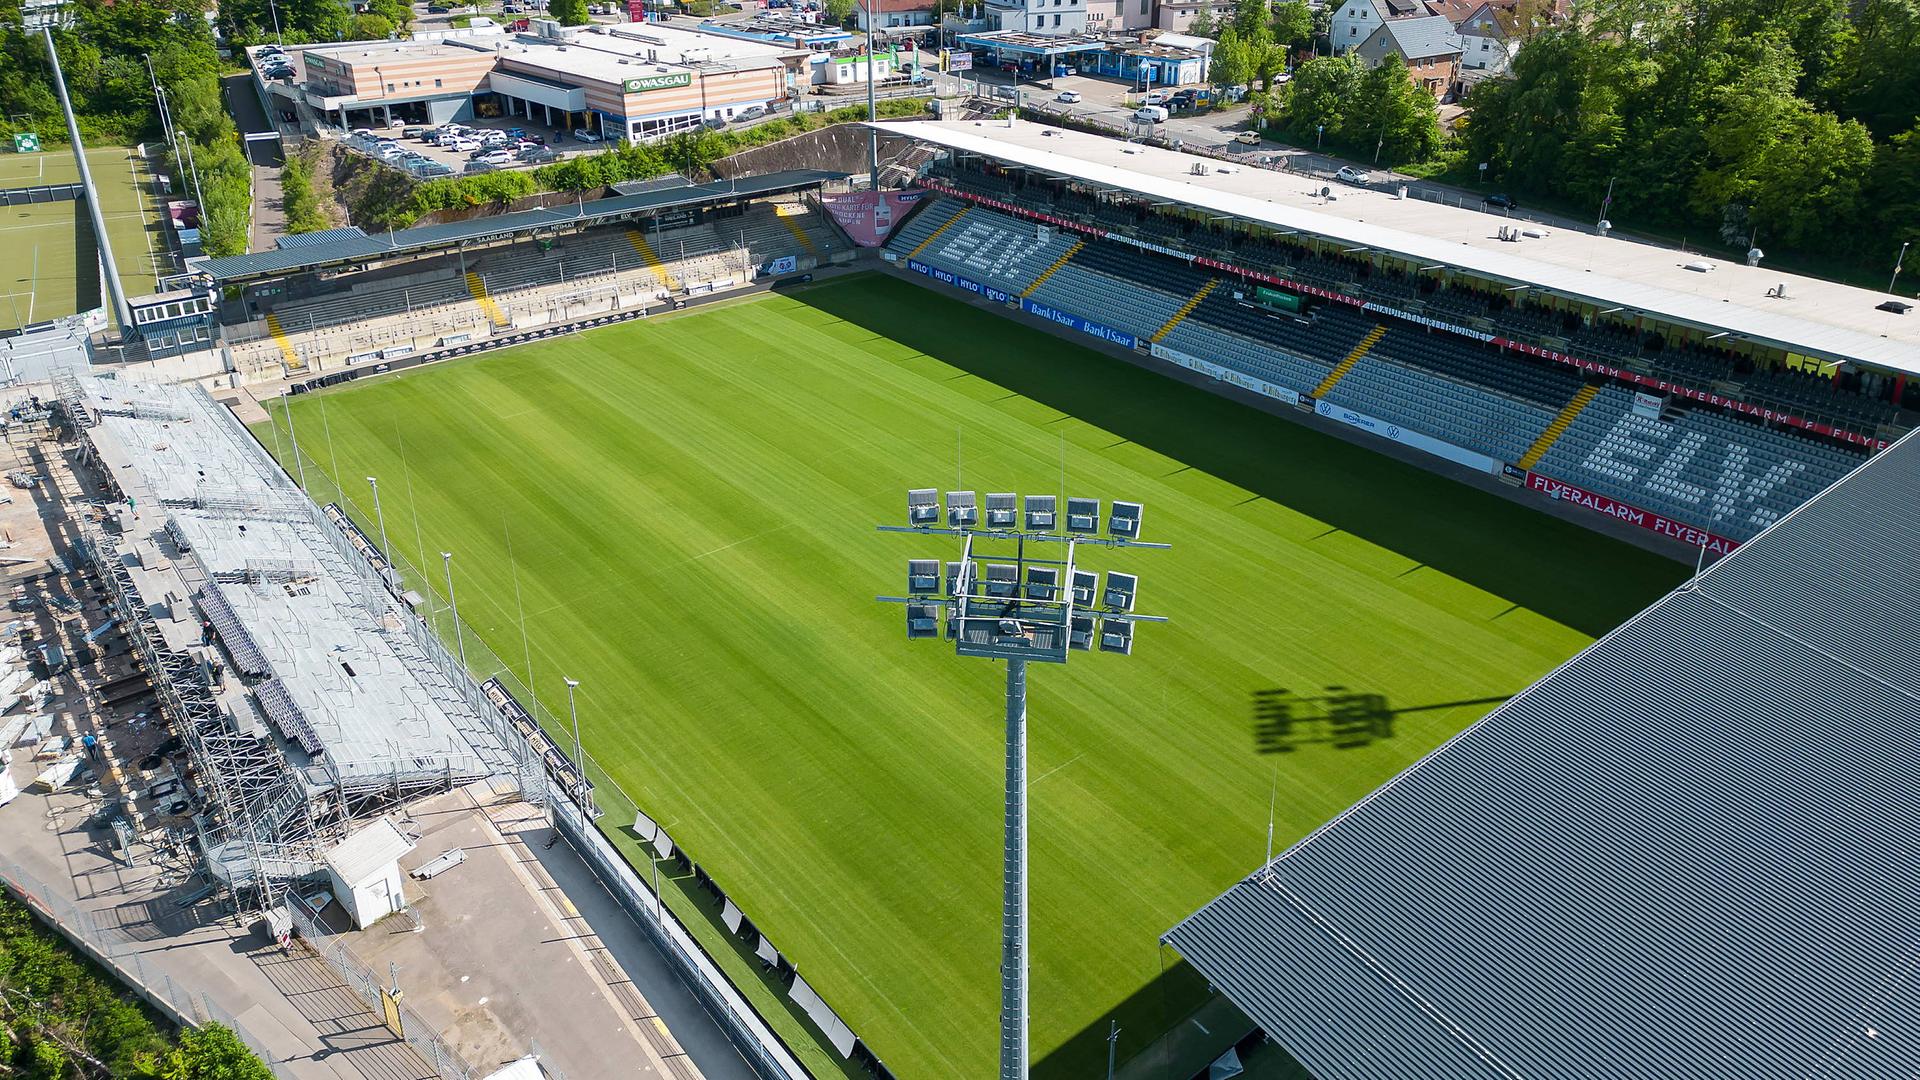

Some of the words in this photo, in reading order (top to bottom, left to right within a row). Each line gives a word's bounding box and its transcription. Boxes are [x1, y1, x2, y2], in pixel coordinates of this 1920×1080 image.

[640, 74, 689, 88] WASGAU
[977, 196, 1029, 216] FLYERALARM
[551, 222, 575, 231] HEIMAT
[1046, 215, 1104, 236] FLYERALARM
[477, 232, 514, 243] SAARLAND
[910, 262, 929, 274] HYLO
[1198, 257, 1270, 282] FLYERALARM
[935, 270, 954, 283] HYLO
[960, 279, 979, 292] HYLO
[1280, 279, 1360, 307] FLYERALARM
[986, 288, 1007, 301] HYLO
[1508, 340, 1618, 377] FLYERALARM
[1658, 381, 1787, 424] FLYERALARM
[1344, 413, 1375, 428] SCHERER
[1534, 477, 1644, 526] FLYERALARM
